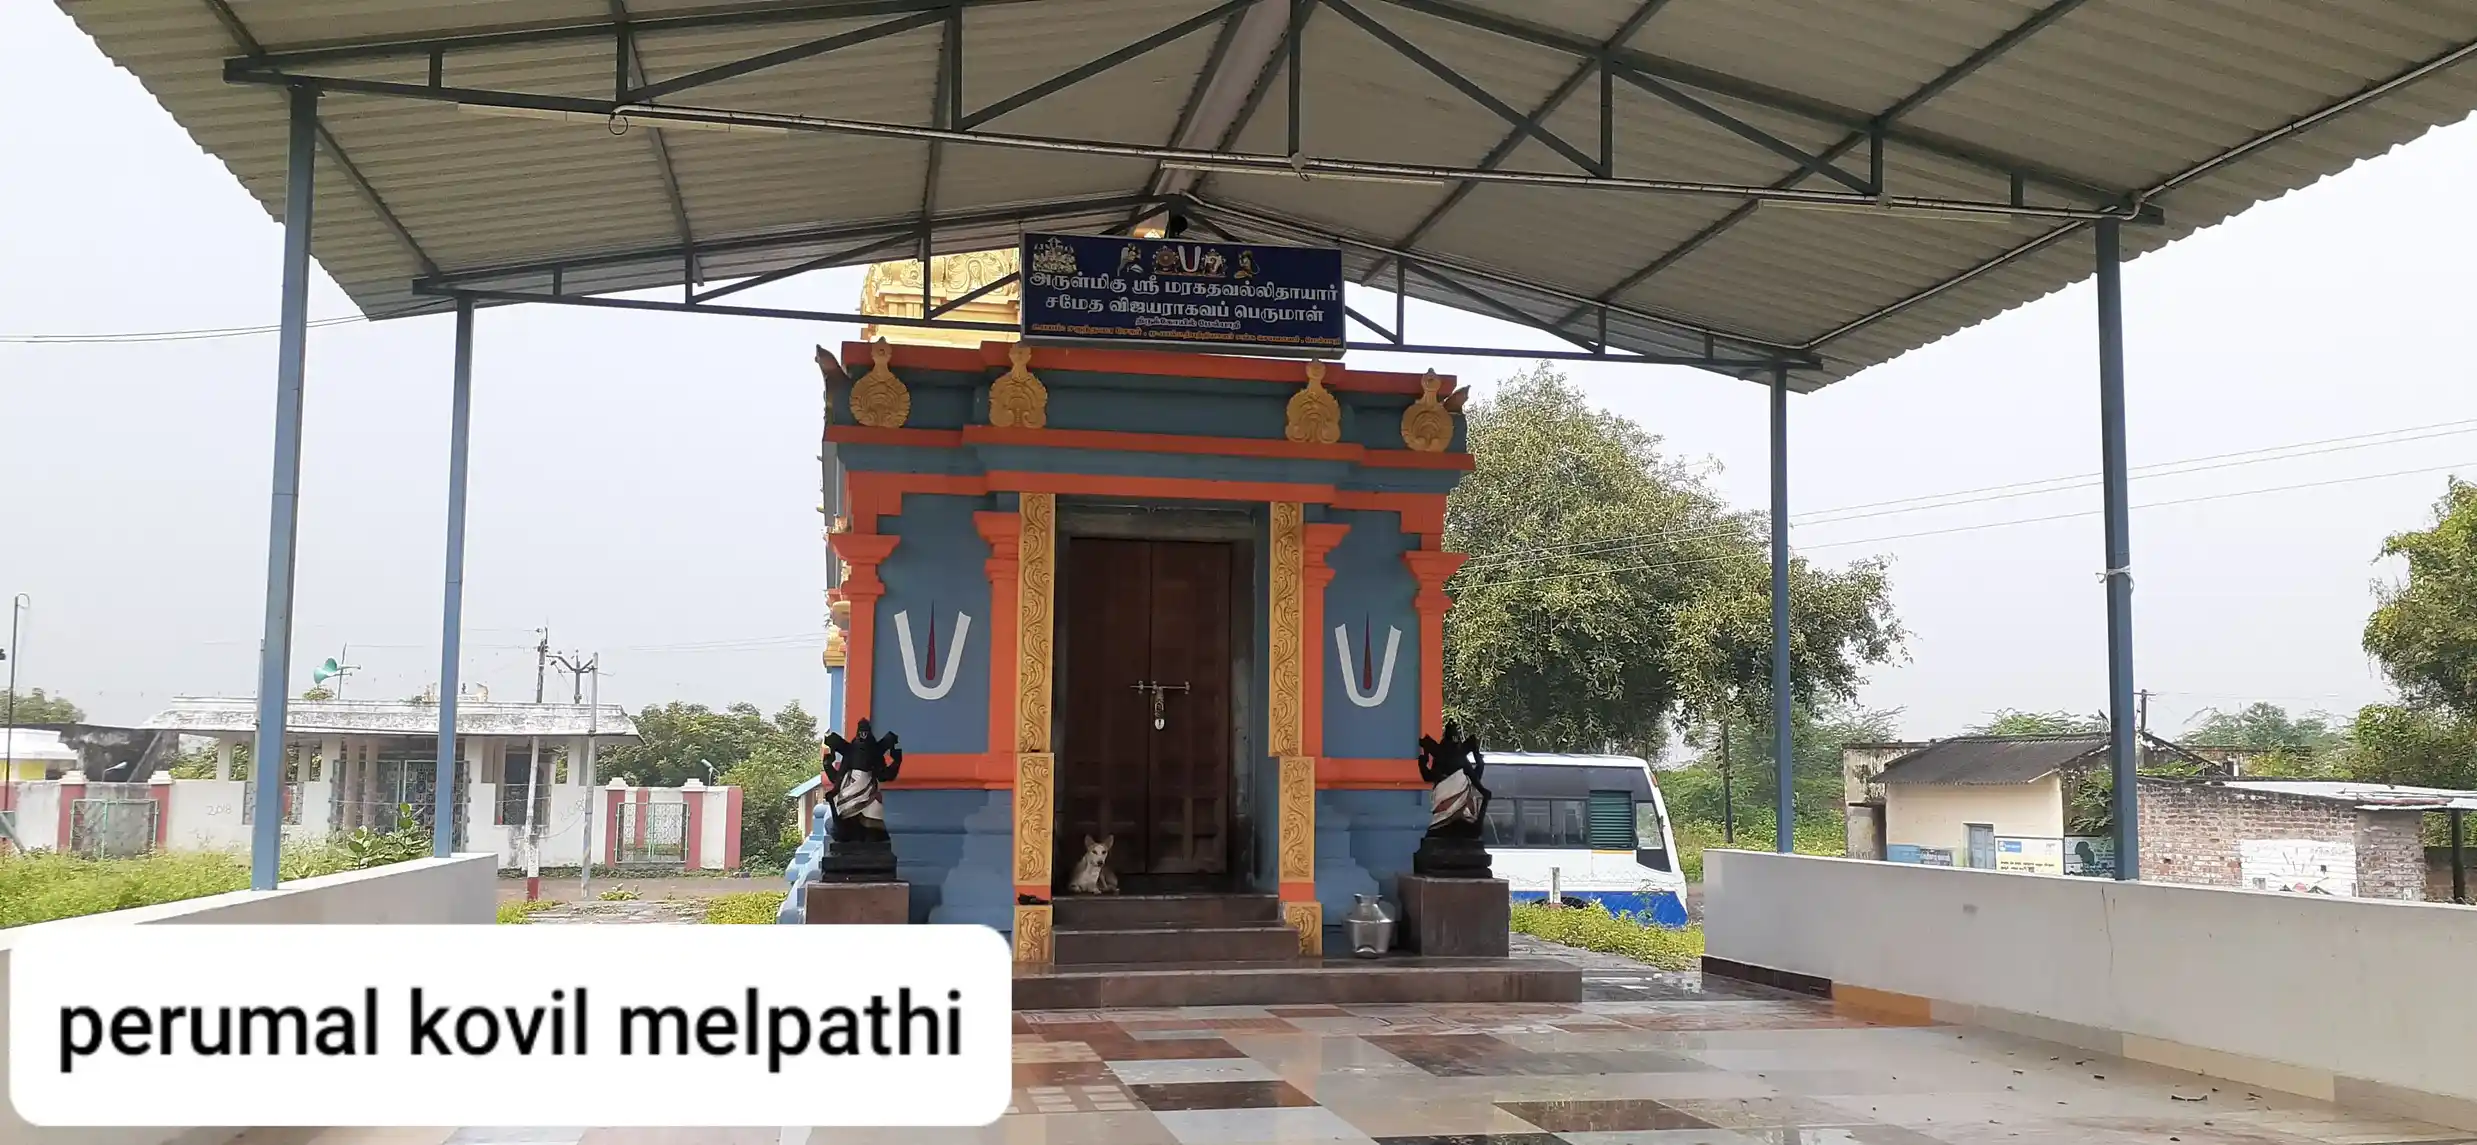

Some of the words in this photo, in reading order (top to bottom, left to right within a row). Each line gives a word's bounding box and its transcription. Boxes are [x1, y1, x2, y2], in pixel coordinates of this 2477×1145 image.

[1030, 271, 1127, 293] அருள்மிகு
[1132, 274, 1160, 295] ஸ்ரீ
[1165, 279, 1338, 301] மரகதவல்லிதாயார்
[1045, 294, 1104, 313] சமேத
[1109, 296, 1229, 317] விஜயராகவப்
[1234, 304, 1325, 323] பெருமாள்
